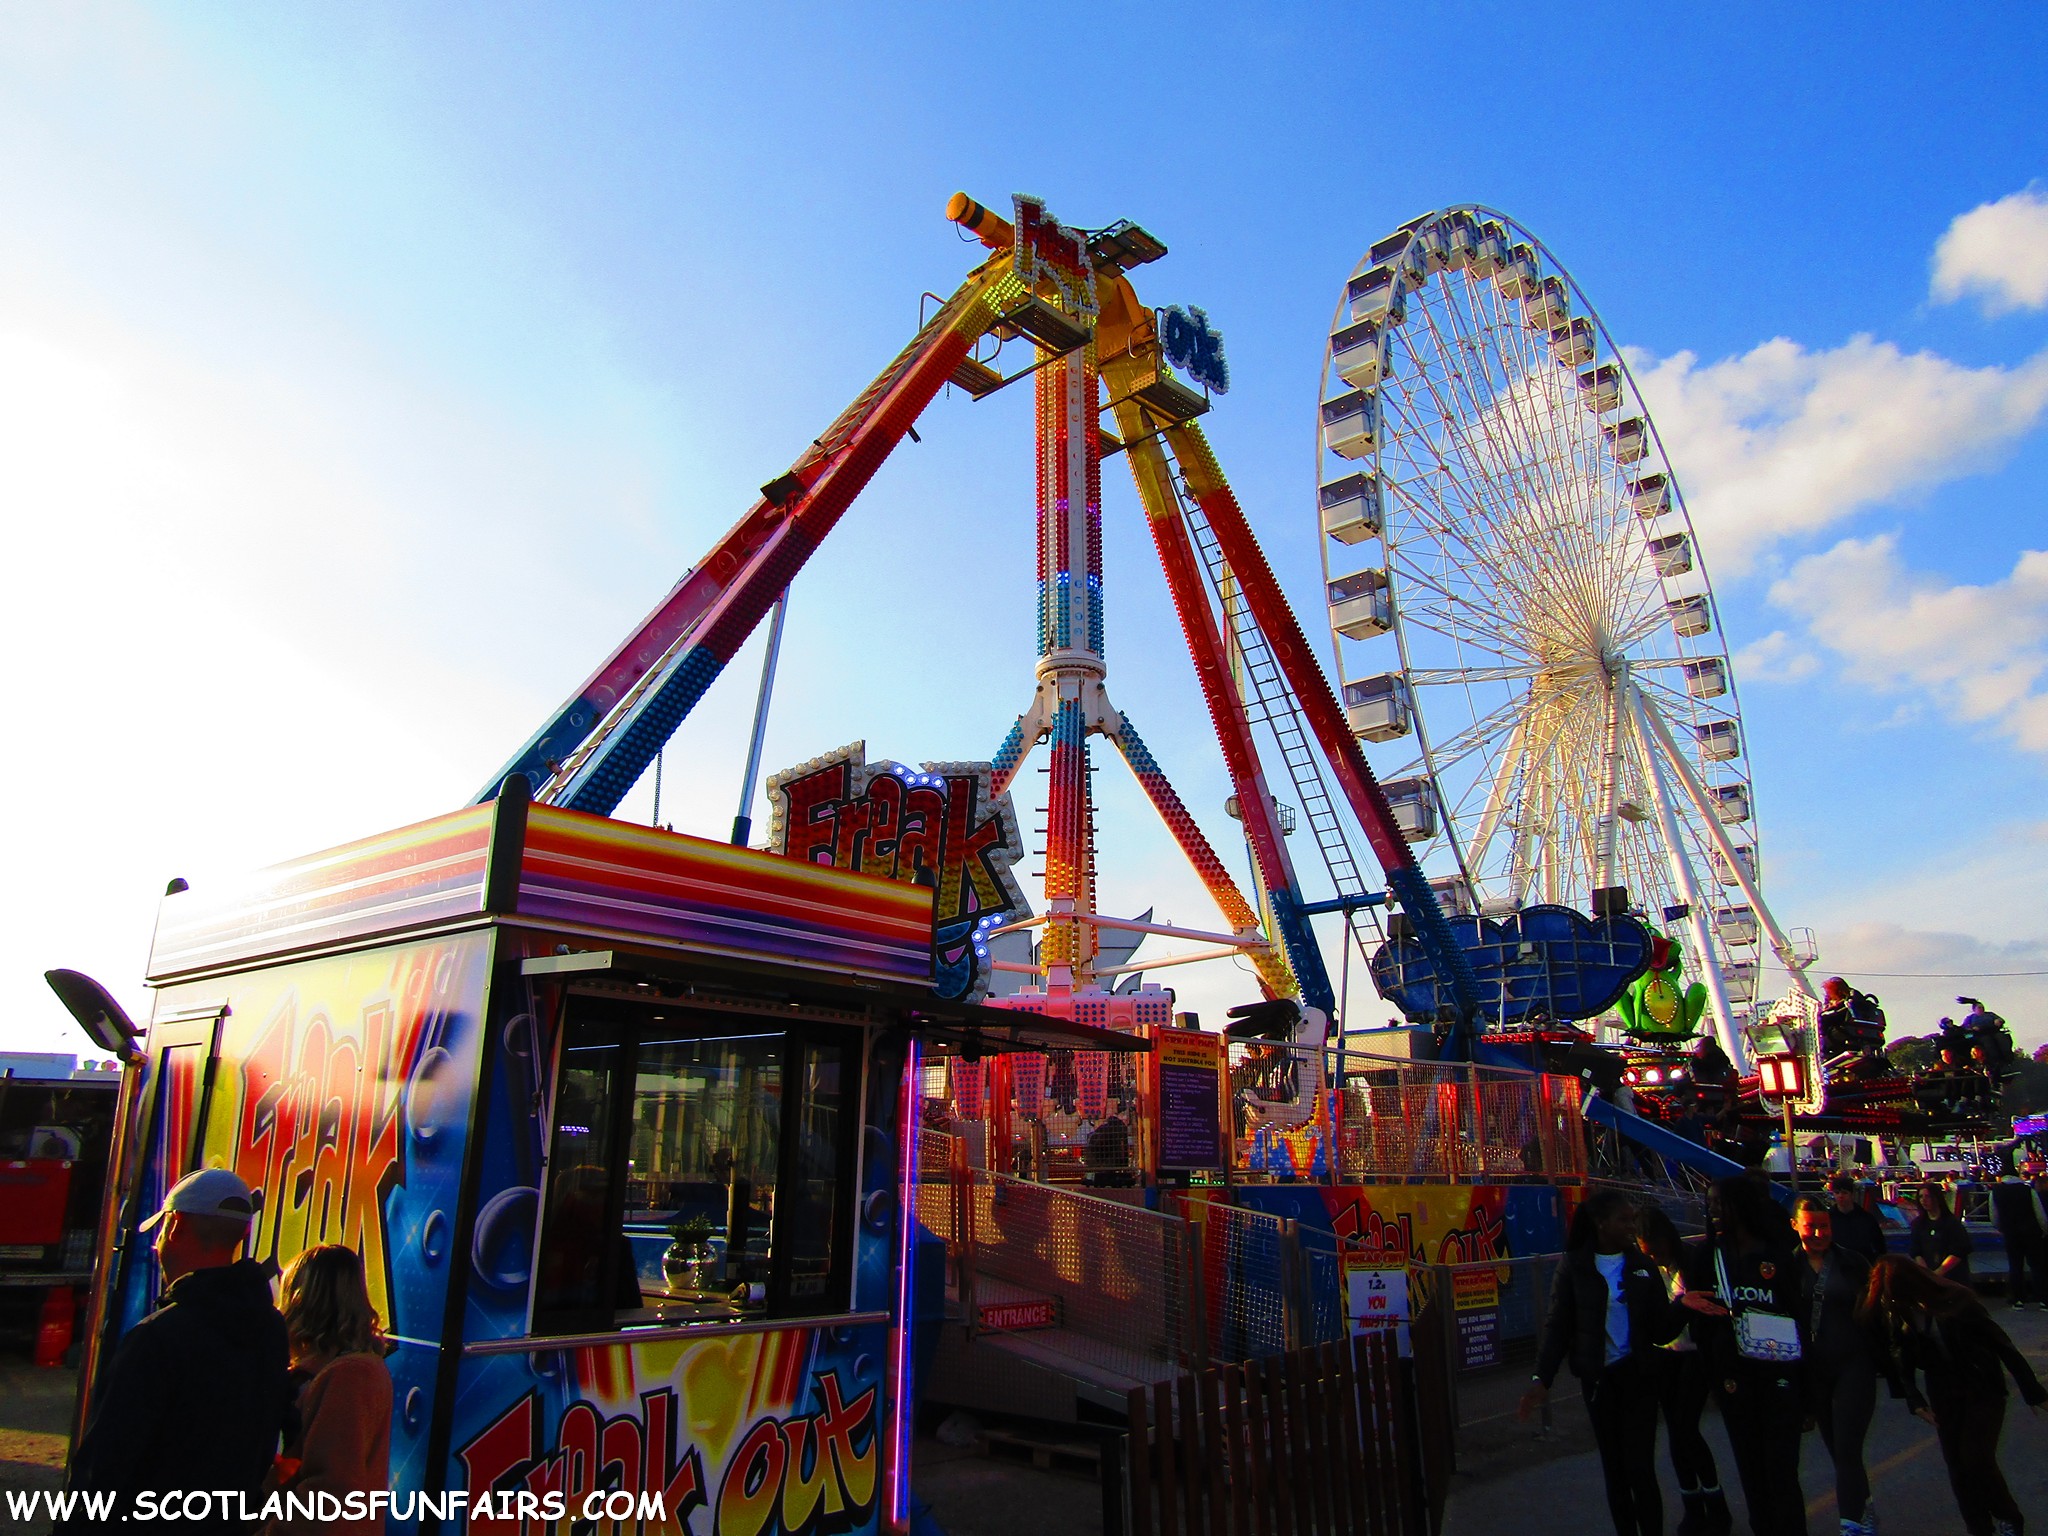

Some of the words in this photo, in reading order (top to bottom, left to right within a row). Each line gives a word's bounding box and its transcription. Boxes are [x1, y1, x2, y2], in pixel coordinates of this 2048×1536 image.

[780, 758, 1016, 920] Freak
[1177, 1057, 1204, 1065] SUITABLE
[236, 995, 405, 1340] Freak
[987, 1305, 1047, 1328] ENTRANCE
[1368, 1295, 1386, 1309] YOU
[456, 1384, 708, 1536] Freak
[716, 1368, 881, 1536] out
